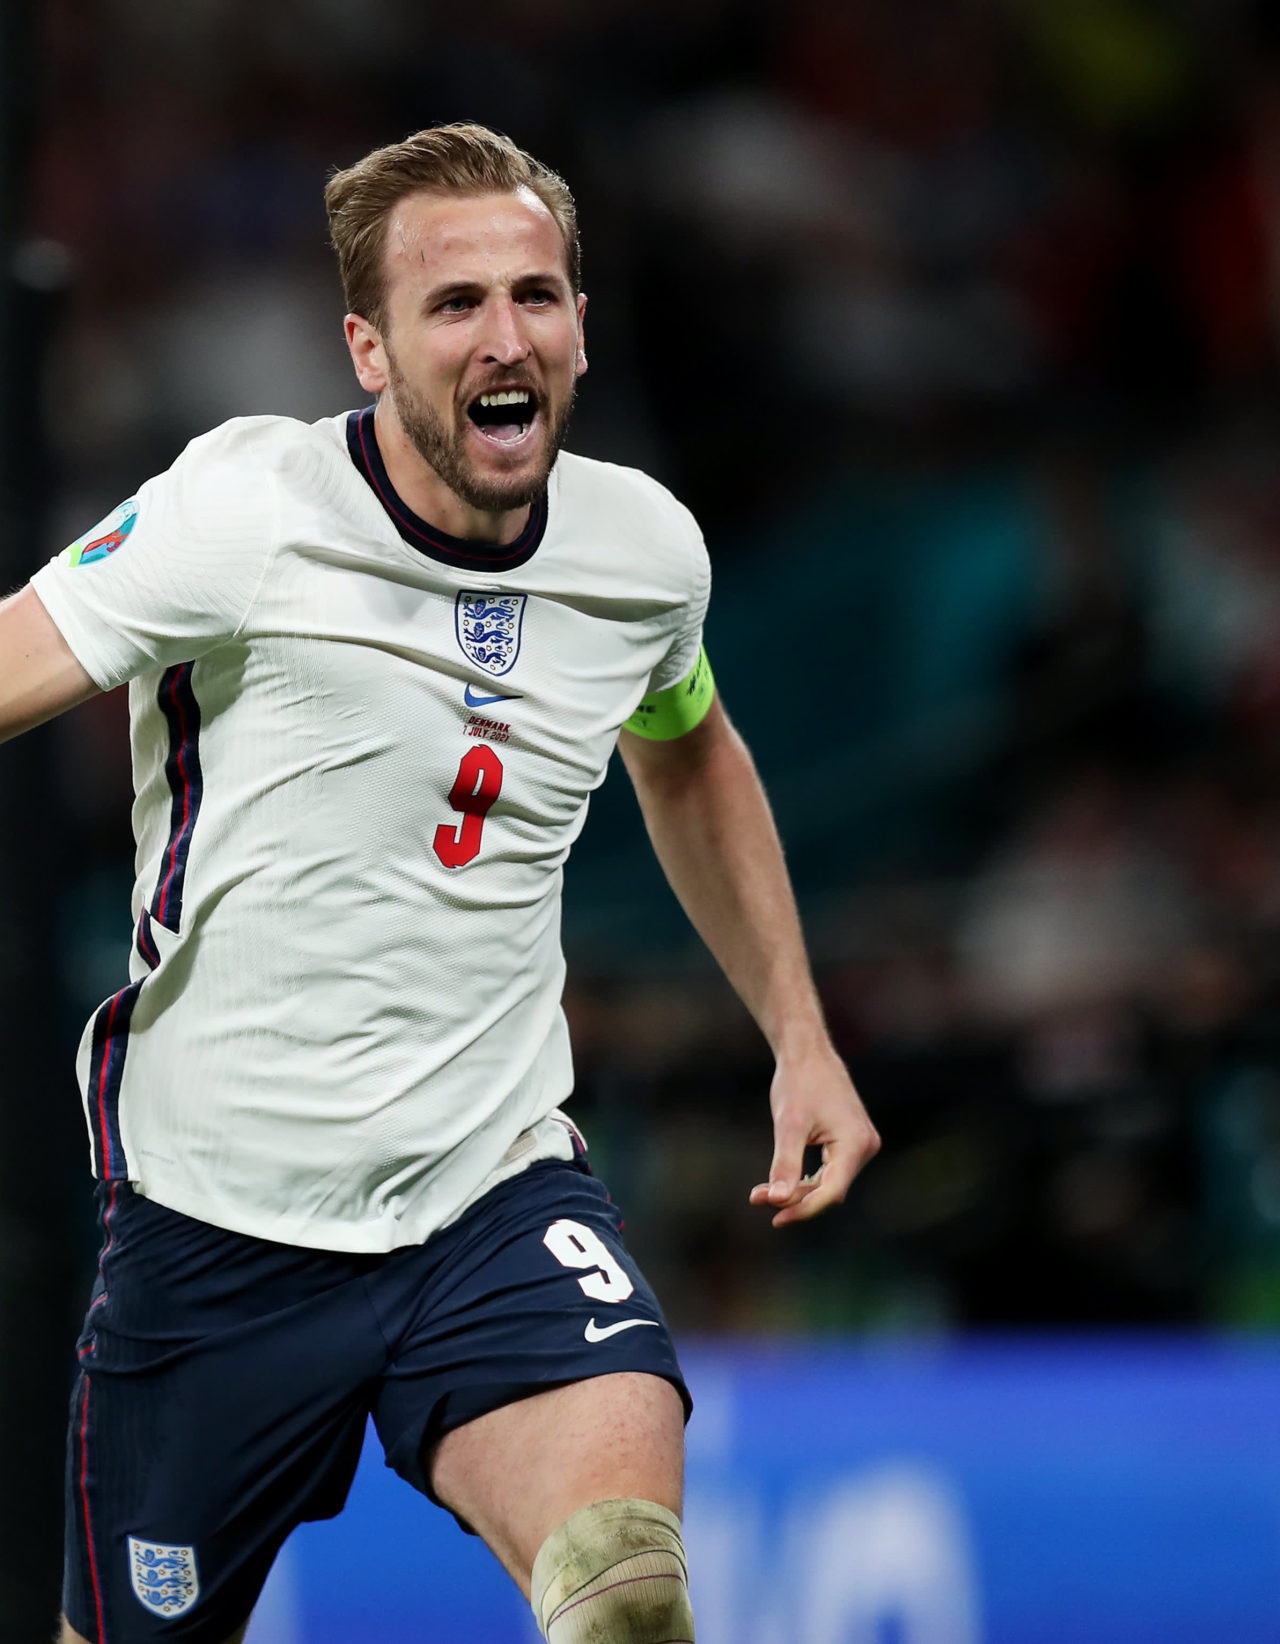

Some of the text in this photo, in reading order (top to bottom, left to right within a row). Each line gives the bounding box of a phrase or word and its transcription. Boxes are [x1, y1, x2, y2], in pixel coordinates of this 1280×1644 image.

[463, 724, 510, 742] 7 JULY 2021
[468, 716, 511, 732] DENMARK
[433, 744, 503, 868] 9
[542, 1219, 634, 1303] 9
